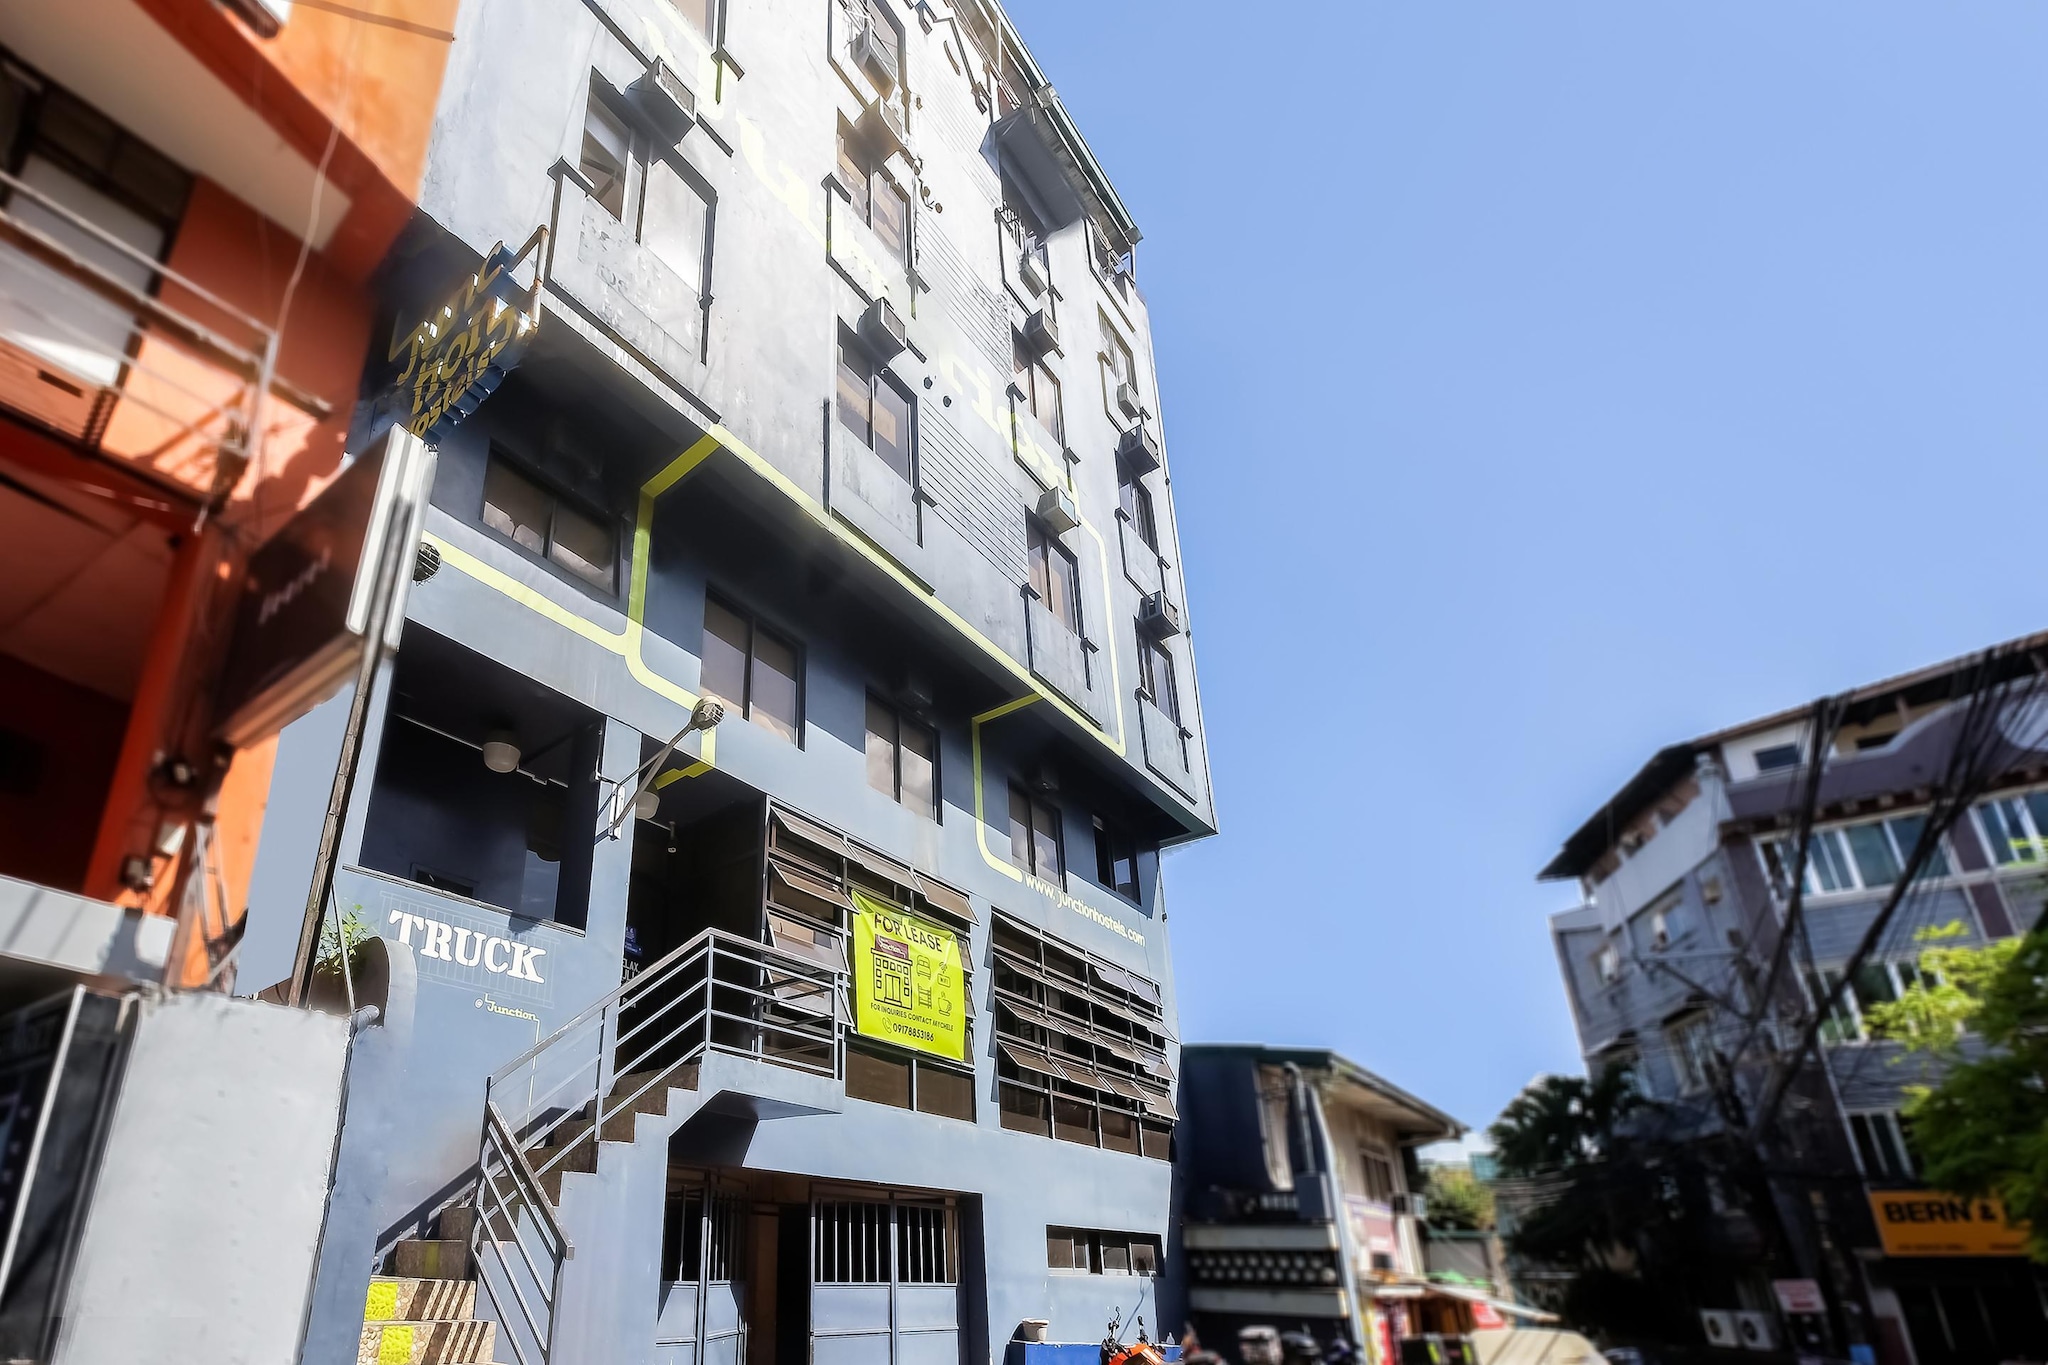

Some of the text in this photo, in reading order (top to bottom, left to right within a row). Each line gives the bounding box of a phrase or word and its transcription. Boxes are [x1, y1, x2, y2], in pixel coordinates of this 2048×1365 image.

[875, 912, 943, 953] FOR LEASE
[388, 909, 547, 984] TRUCK
[485, 1000, 537, 1021] Junction
[871, 1002, 881, 1011] FOR
[881, 1007, 907, 1019] INQUIRIES
[908, 1013, 932, 1025] CONTACT
[892, 1022, 935, 1042] 09178853186
[1884, 1199, 1971, 1223] BERN
